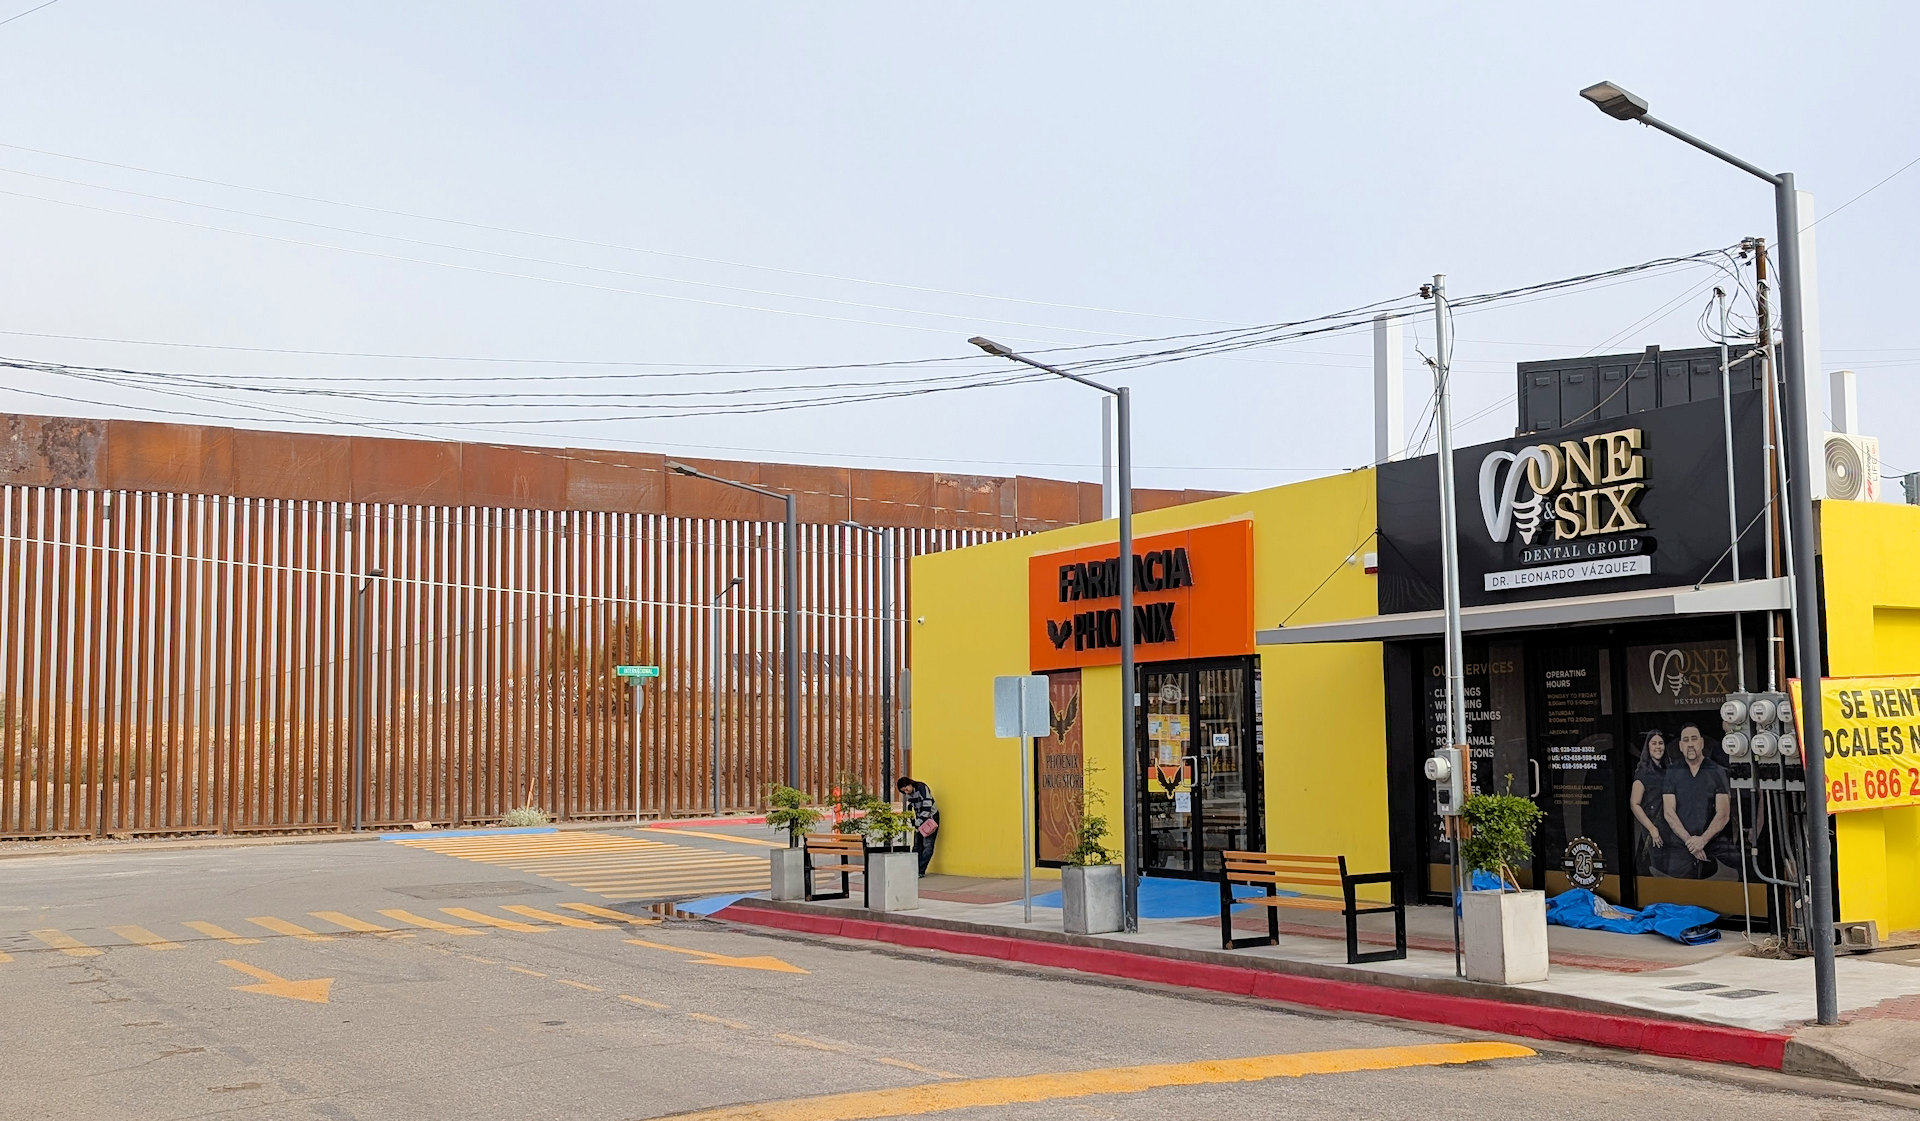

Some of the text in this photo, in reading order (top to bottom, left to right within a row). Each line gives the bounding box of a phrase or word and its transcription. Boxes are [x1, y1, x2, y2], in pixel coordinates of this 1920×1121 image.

[1527, 428, 1643, 495] ONE
[1555, 482, 1647, 540] SIX
[1523, 538, 1639, 563] DENTAL GROUP
[1492, 561, 1637, 587] DR. LEONARDO VÁZQUEZ
[1073, 602, 1176, 651] PHONIX
[1463, 661, 1514, 676] ERVICES
[1545, 668, 1587, 679] OPERATING
[1674, 648, 1729, 674] ONE
[1545, 680, 1571, 688] HOURS
[1688, 672, 1730, 696] SIX
[1839, 690, 1868, 719] SE
[1467, 735, 1496, 746] ANALS
[1823, 726, 1904, 759] OCALES
[1046, 754, 1078, 769] PHOENIX
[1042, 774, 1062, 788] DRUG
[1864, 768, 1901, 800] 686
[1576, 852, 1592, 877] 25
